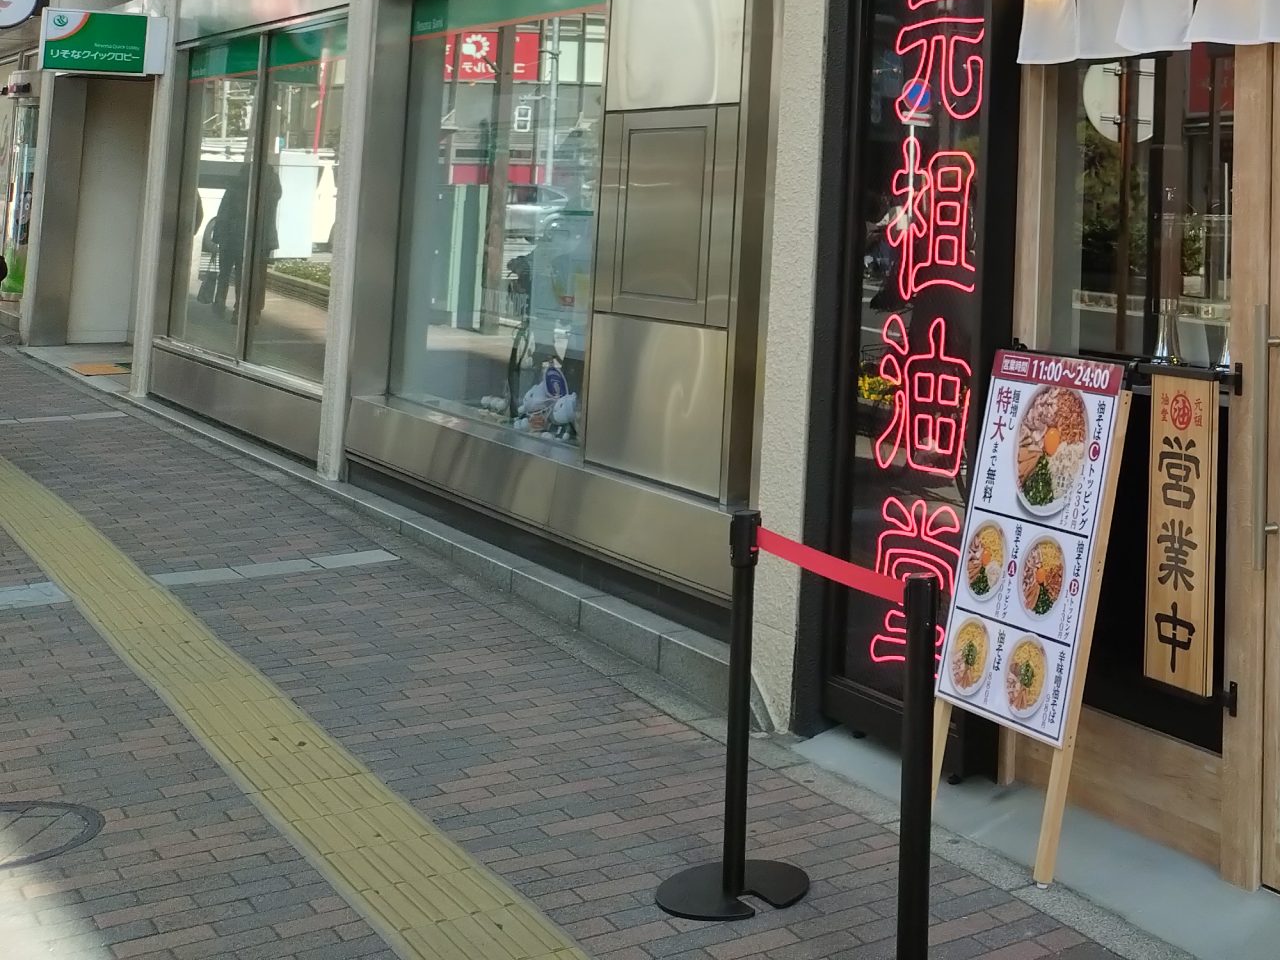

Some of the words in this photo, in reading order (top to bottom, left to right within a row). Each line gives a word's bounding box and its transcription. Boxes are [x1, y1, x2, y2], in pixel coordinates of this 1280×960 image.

[50, 49, 140, 61] りそなクイックロビー
[1154, 436, 1201, 674] 営業中
